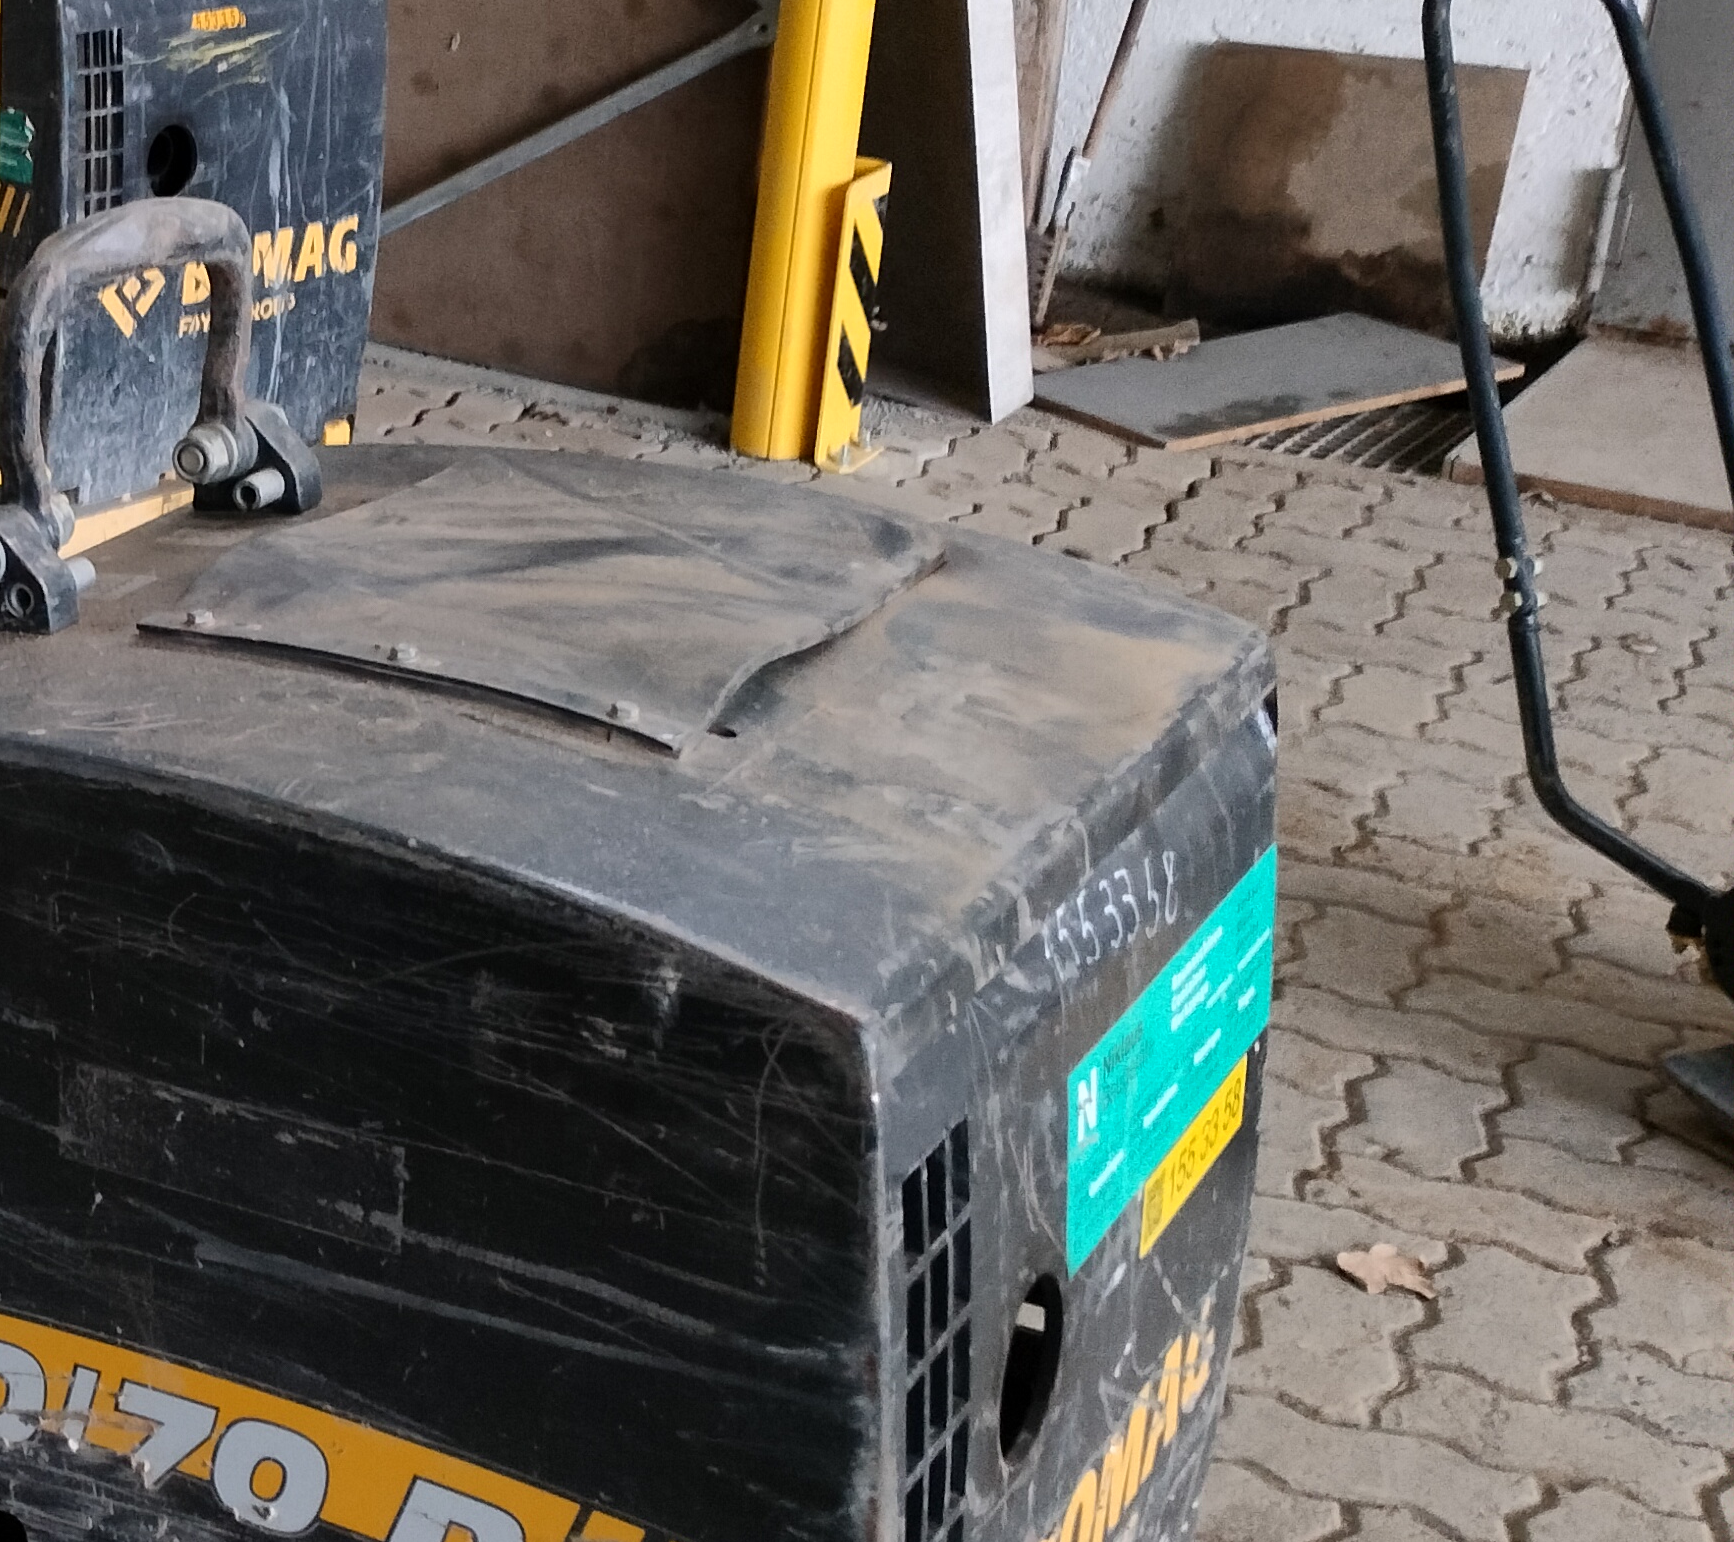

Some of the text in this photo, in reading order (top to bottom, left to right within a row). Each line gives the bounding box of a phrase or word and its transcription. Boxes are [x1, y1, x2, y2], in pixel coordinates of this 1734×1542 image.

[182, 213, 359, 306] BMAG
[1170, 1077, 1242, 1202] 155 33 58
